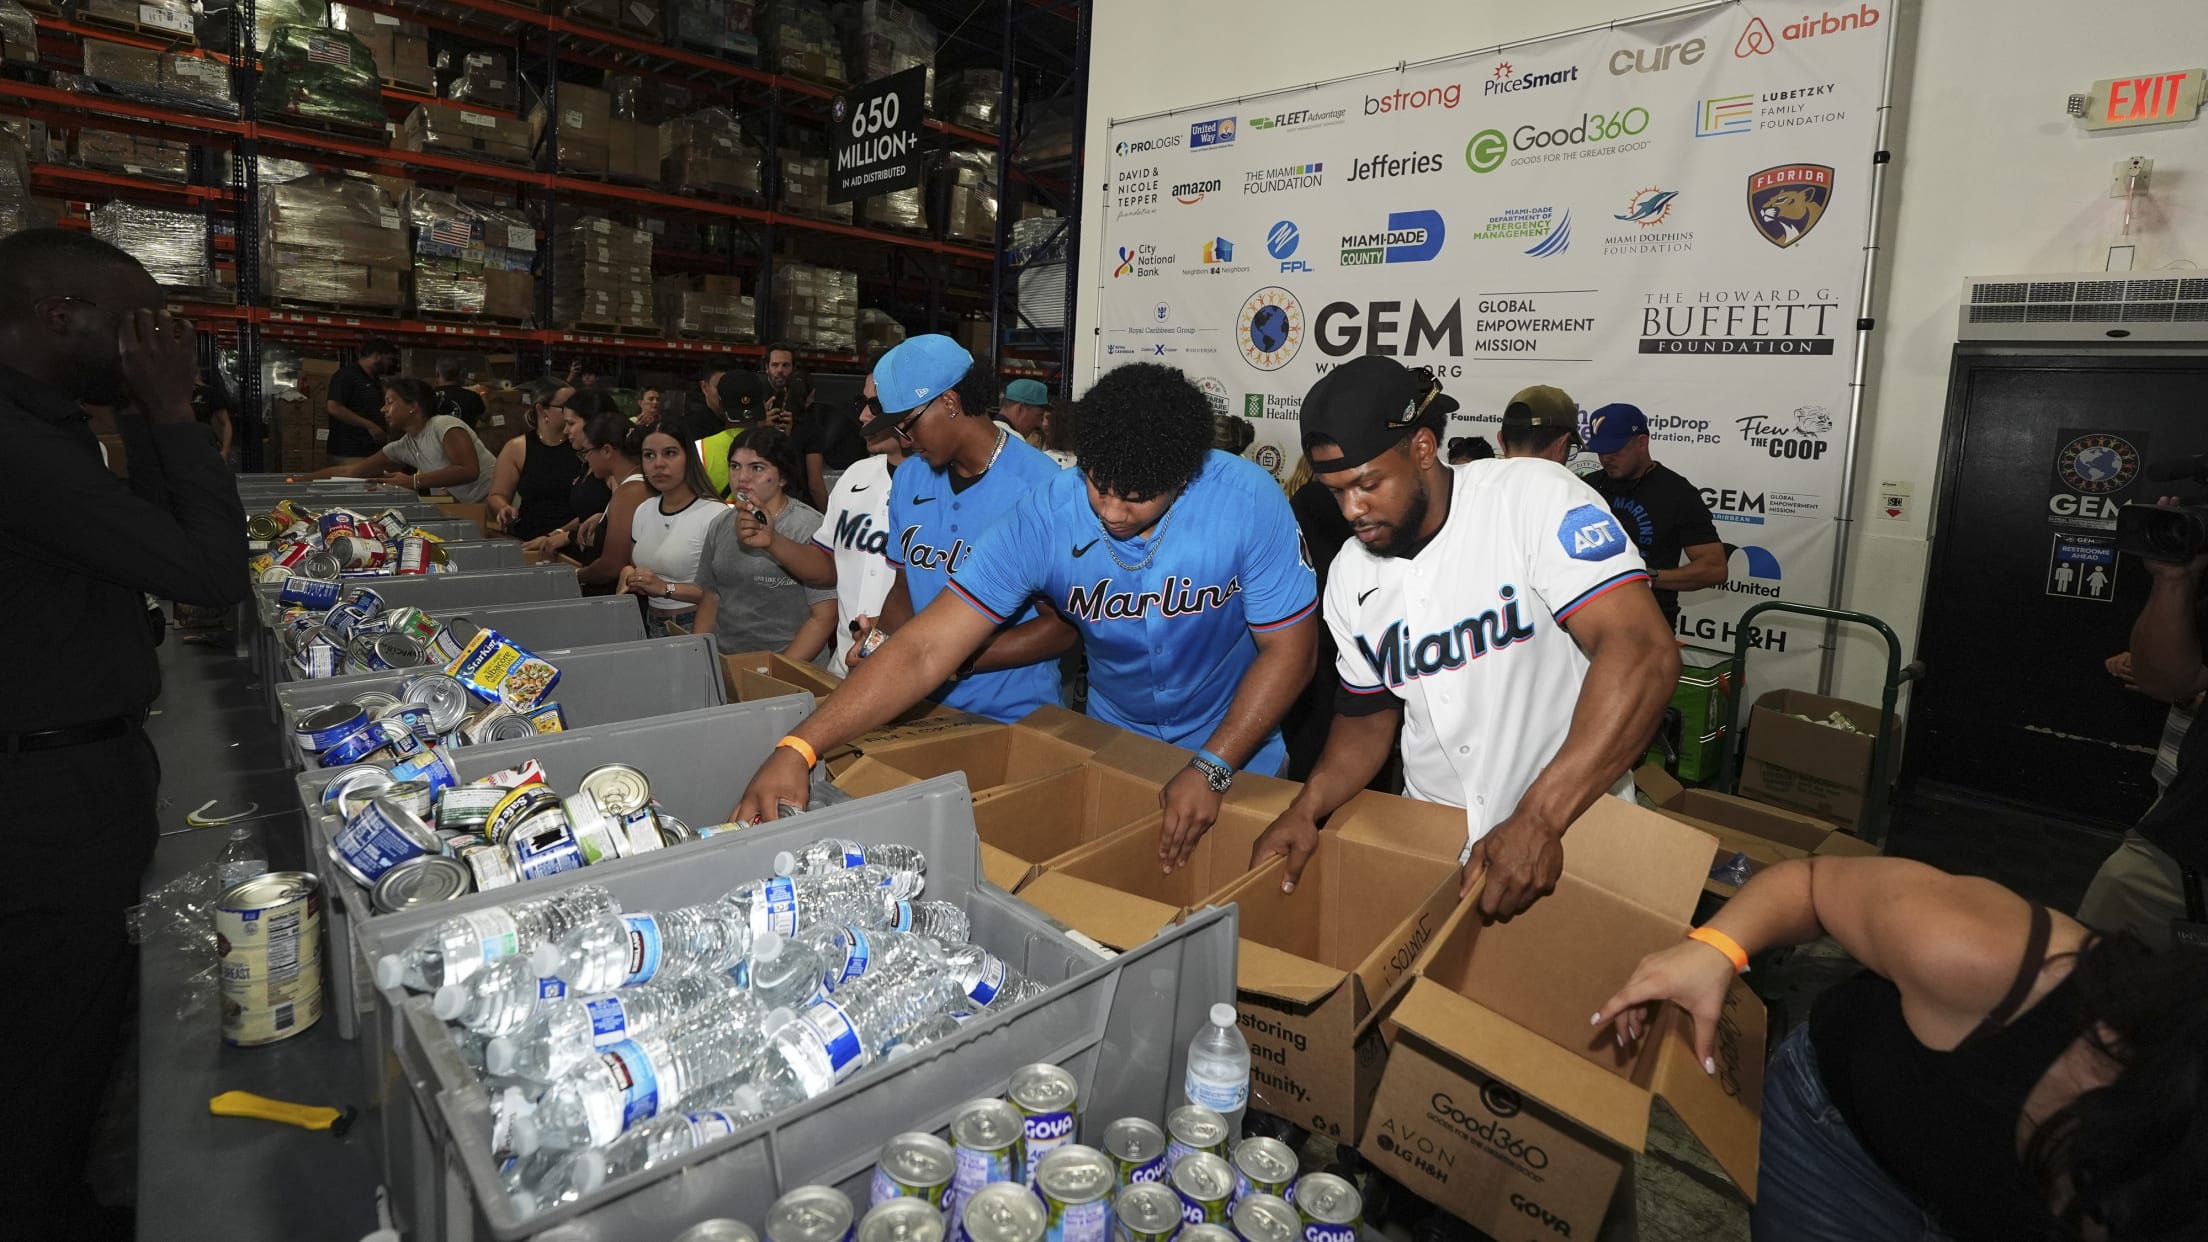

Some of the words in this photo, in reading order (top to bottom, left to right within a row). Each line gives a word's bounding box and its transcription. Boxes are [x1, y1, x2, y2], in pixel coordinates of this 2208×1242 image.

[1782, 4, 1880, 41] airbnb
[1609, 37, 1706, 76] cure
[1484, 65, 1578, 96] PriceSmart
[1364, 83, 1461, 116] bstrong
[1762, 83, 1836, 103] LUBETZKY
[2106, 73, 2187, 122] EXIT
[852, 92, 899, 138] 650
[1761, 103, 1806, 116] FAMILY
[1192, 122, 1216, 135] United
[1512, 107, 1650, 151] Good360
[1760, 111, 1846, 130] FOUNDATION
[1130, 136, 1181, 153] PROLOGIS
[1200, 133, 1216, 144] Way
[837, 130, 918, 172] MILLION+
[1510, 155, 1541, 167] GOODS
[1544, 153, 1560, 163] FOR
[1562, 151, 1577, 161] THE
[1579, 146, 1616, 159] GREATER
[1119, 168, 1150, 182] DAVID
[1152, 167, 1159, 177] &
[1246, 170, 1264, 182] THE
[1266, 166, 1296, 179] MIAMI
[1347, 151, 1443, 182] Jefferies
[842, 178, 850, 189] IN
[851, 174, 862, 187] AID
[863, 165, 907, 184] DISTRIBUTED
[1243, 174, 1323, 195] FOUNDATION
[1756, 169, 1825, 189] FLORIDA
[1118, 181, 1159, 195] NICOLE
[1171, 179, 1221, 197] amazon
[1118, 194, 1158, 207] TEPPER
[1489, 214, 1540, 223] DEPARTMENT
[1505, 206, 1553, 216] MIAMI-DADE
[1473, 227, 1550, 241] MANAGEMENT
[1486, 219, 1552, 232] EMERGENCY
[1604, 235, 1637, 245] MIAMI
[1639, 231, 1694, 243] DOLPHINS
[1139, 244, 1156, 255] City
[1341, 251, 1384, 267] COUNTY
[1603, 243, 1693, 256] FOUNDATION
[1138, 254, 1176, 266] National
[1280, 261, 1312, 273] FPL
[1137, 267, 1159, 277] Bank
[1221, 266, 1250, 274] Neighbors
[1645, 291, 1684, 304] THE
[1699, 288, 1801, 303] HOWARD
[1816, 288, 1839, 301] G.
[1478, 300, 1536, 313] GLOBAL
[1128, 327, 1144, 335] Royal
[1176, 326, 1196, 335] Group
[1313, 298, 1464, 357] GEM
[1476, 318, 1595, 332] EMPOWERMENT
[1641, 304, 1838, 338] BUFFETT
[1475, 339, 1537, 352] MISSION
[1658, 341, 1814, 353] FOUNDATION
[1267, 394, 1301, 408] Baptist
[1266, 408, 1300, 420] Health
[1451, 413, 1503, 424] Foundatio
[1648, 415, 1709, 432] ripDrop
[1736, 415, 1790, 441] Flew
[1650, 432, 1695, 444] dration,
[1697, 434, 1721, 444] PBC
[1751, 438, 1768, 448] THE
[1769, 438, 1828, 460] COOP
[1699, 487, 1766, 514] GEM
[1769, 501, 1819, 510] EMPOWERMENT
[1613, 496, 1654, 545] MARLINS
[1712, 513, 1751, 523] ARIBBEAN
[833, 509, 889, 556] Mia
[1575, 520, 1616, 555] ADT
[2062, 546, 2110, 555] RESTROOMS
[1711, 580, 1781, 598] nkUnited
[1353, 583, 1536, 689] Miami
[1680, 615, 1716, 640] LG
[1721, 621, 1787, 652] H&H
[467, 639, 498, 673] StarKist
[484, 651, 512, 682] Albacore
[504, 795, 529, 819] Safe
[1236, 1012, 1307, 1051] storing
[1251, 1043, 1287, 1066] and
[1250, 1066, 1312, 1102] tunity.
[1024, 1115, 1073, 1138] GOYA
[1431, 1092, 1548, 1170] Good360
[1381, 1118, 1456, 1168] AVON
[1131, 1157, 1168, 1184] GOYA
[1393, 1143, 1413, 1163] LG
[1414, 1155, 1449, 1185] H&H
[1181, 1202, 1204, 1223] YA
[1509, 1193, 1572, 1239] GOYA
[1305, 1226, 1355, 1242] GOYA
